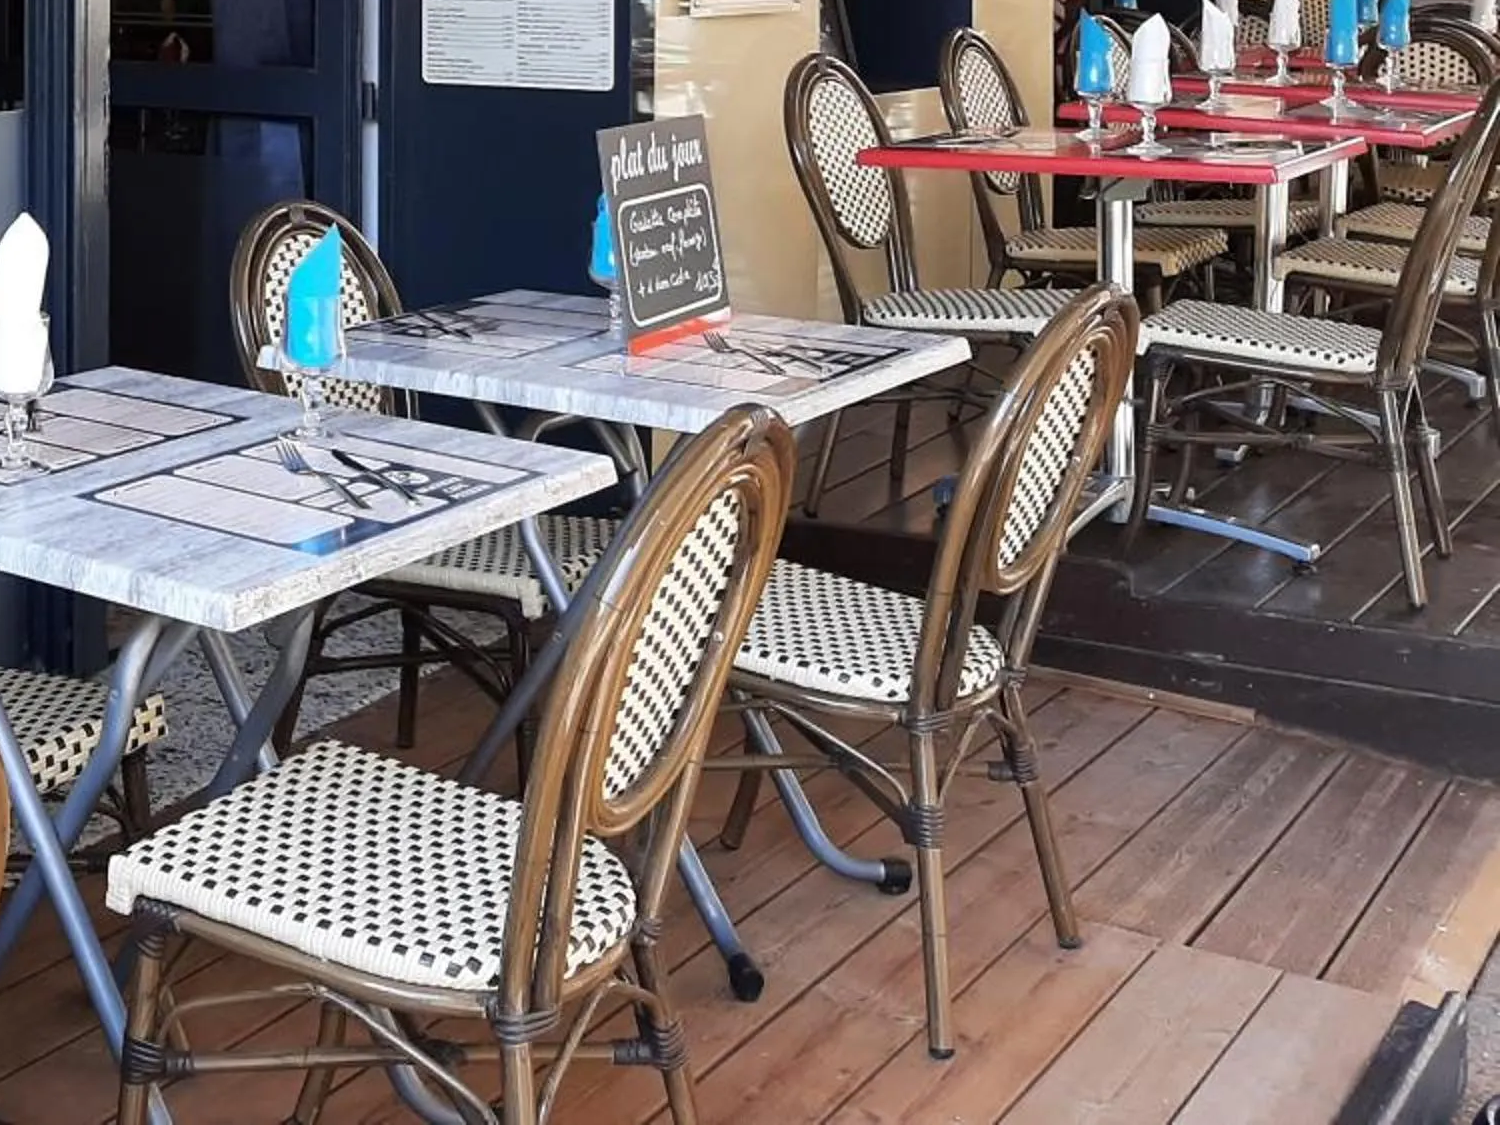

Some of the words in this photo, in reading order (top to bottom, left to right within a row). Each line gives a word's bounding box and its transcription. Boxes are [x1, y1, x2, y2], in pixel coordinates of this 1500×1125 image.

[610, 136, 645, 196] plat
[647, 130, 669, 175] du
[671, 133, 703, 183] jour
